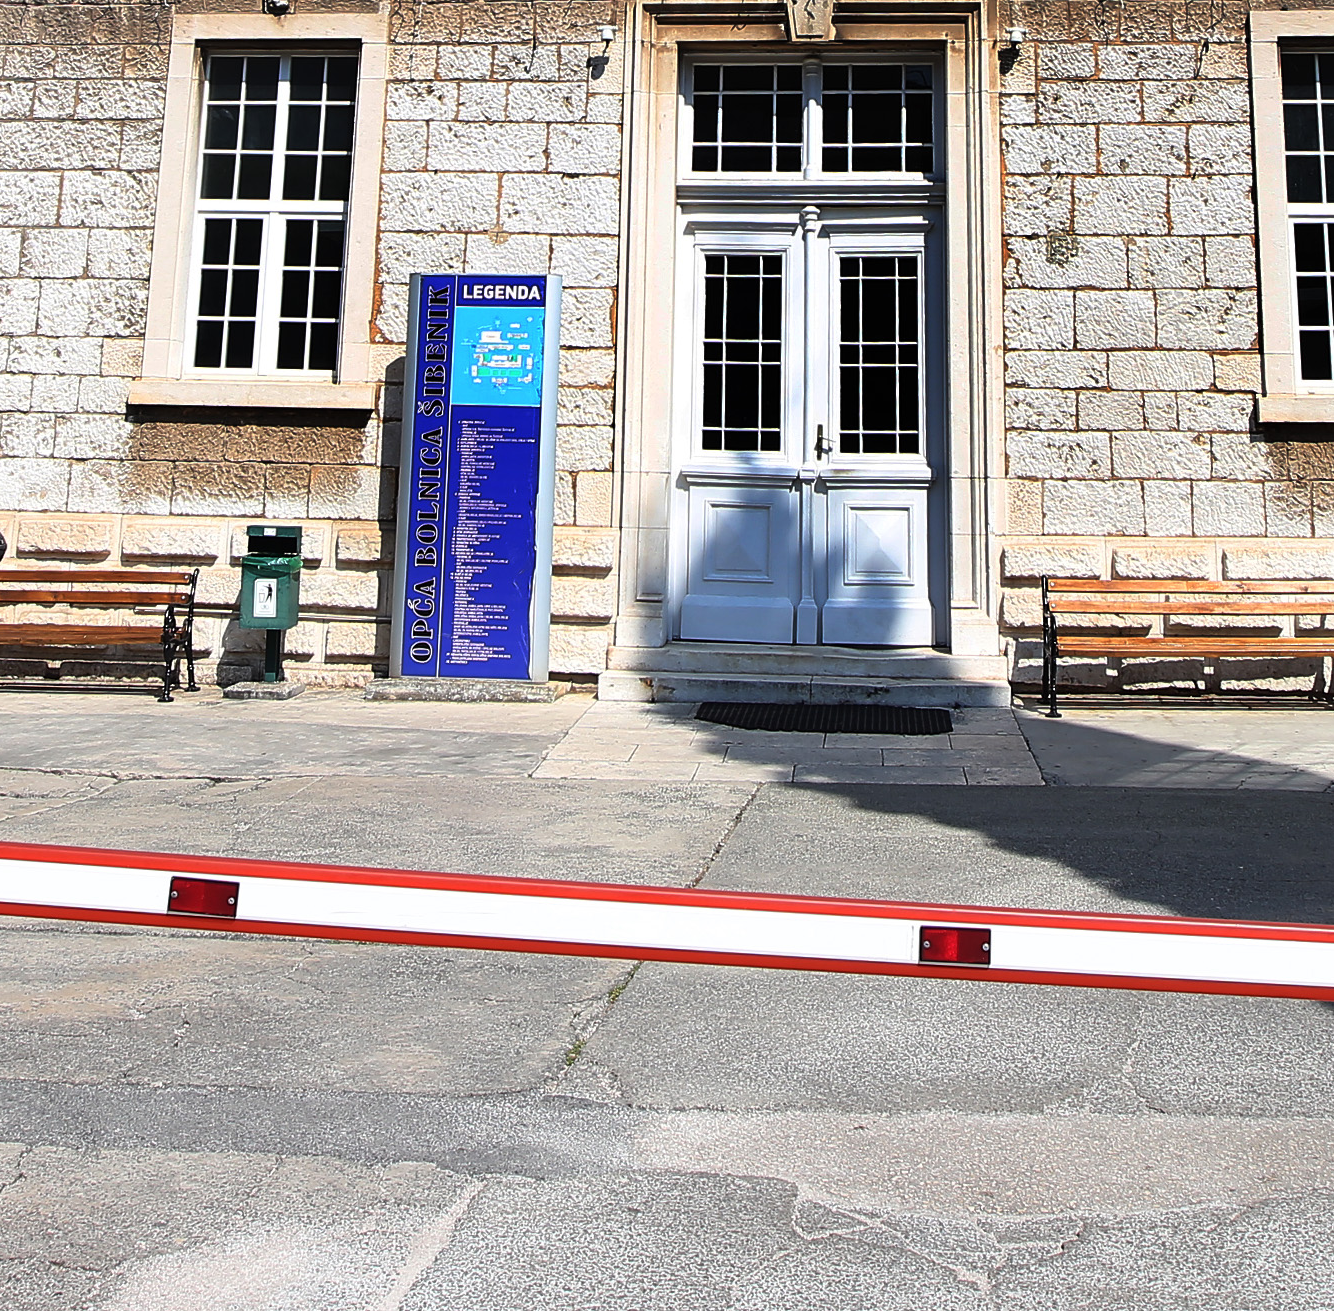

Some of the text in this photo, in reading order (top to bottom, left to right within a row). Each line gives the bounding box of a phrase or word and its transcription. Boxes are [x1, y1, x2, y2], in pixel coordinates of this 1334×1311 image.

[463, 284, 541, 300] LEGENDA
[408, 285, 450, 664] OPĆA BOLNICA ŠIBENIK
